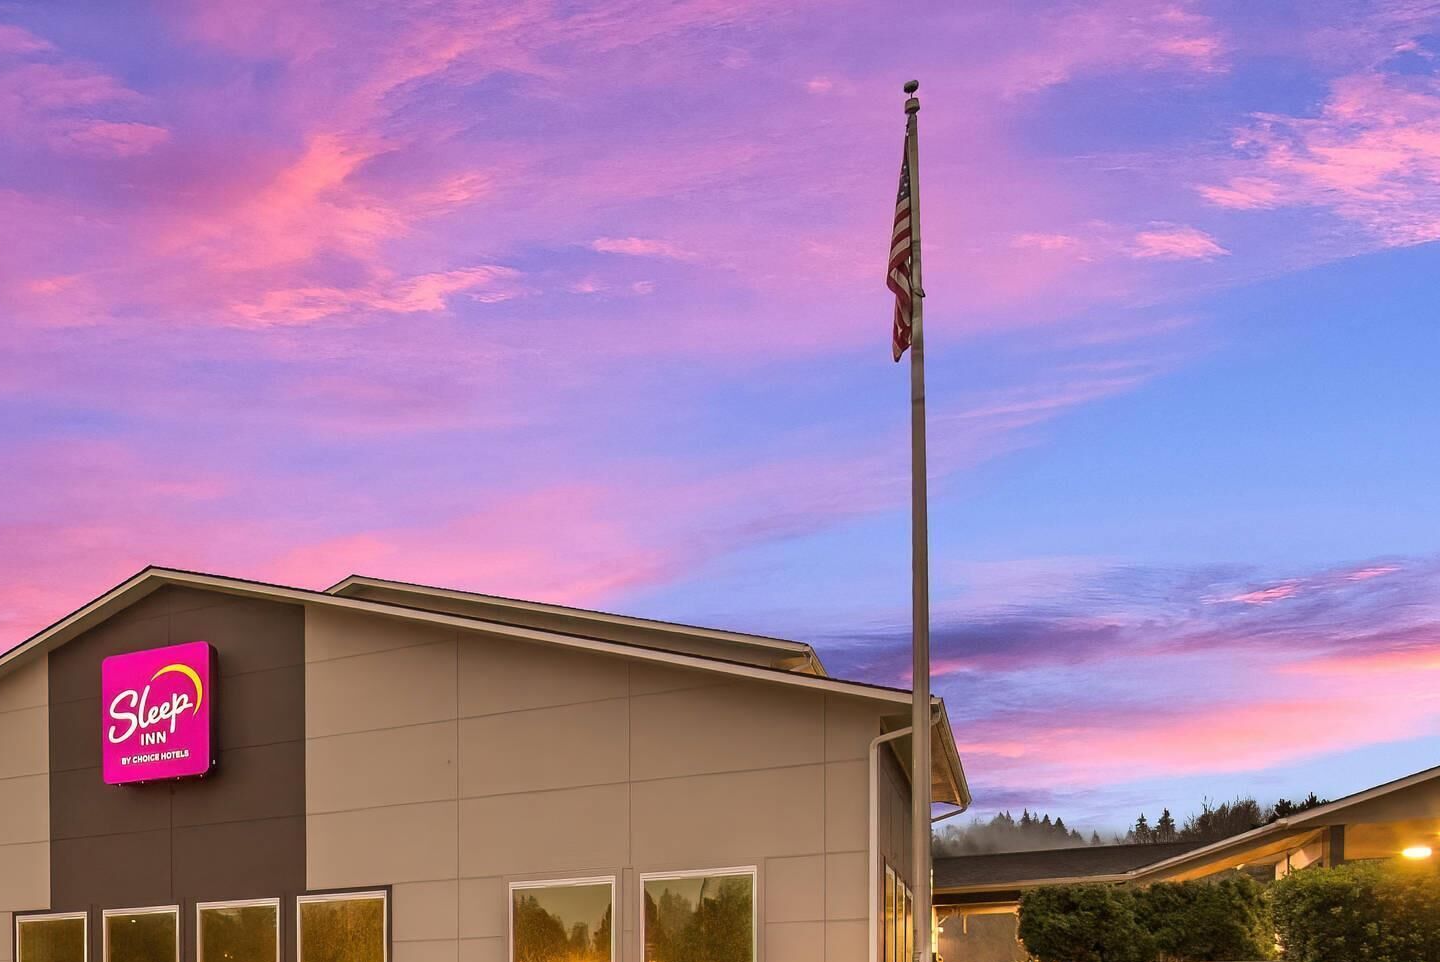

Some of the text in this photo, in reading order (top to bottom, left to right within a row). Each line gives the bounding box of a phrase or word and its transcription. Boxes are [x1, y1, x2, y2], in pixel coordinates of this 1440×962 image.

[108, 685, 194, 744] Sleep
[140, 731, 167, 746] INN
[121, 749, 190, 765] BY CHOICE HOTELS
